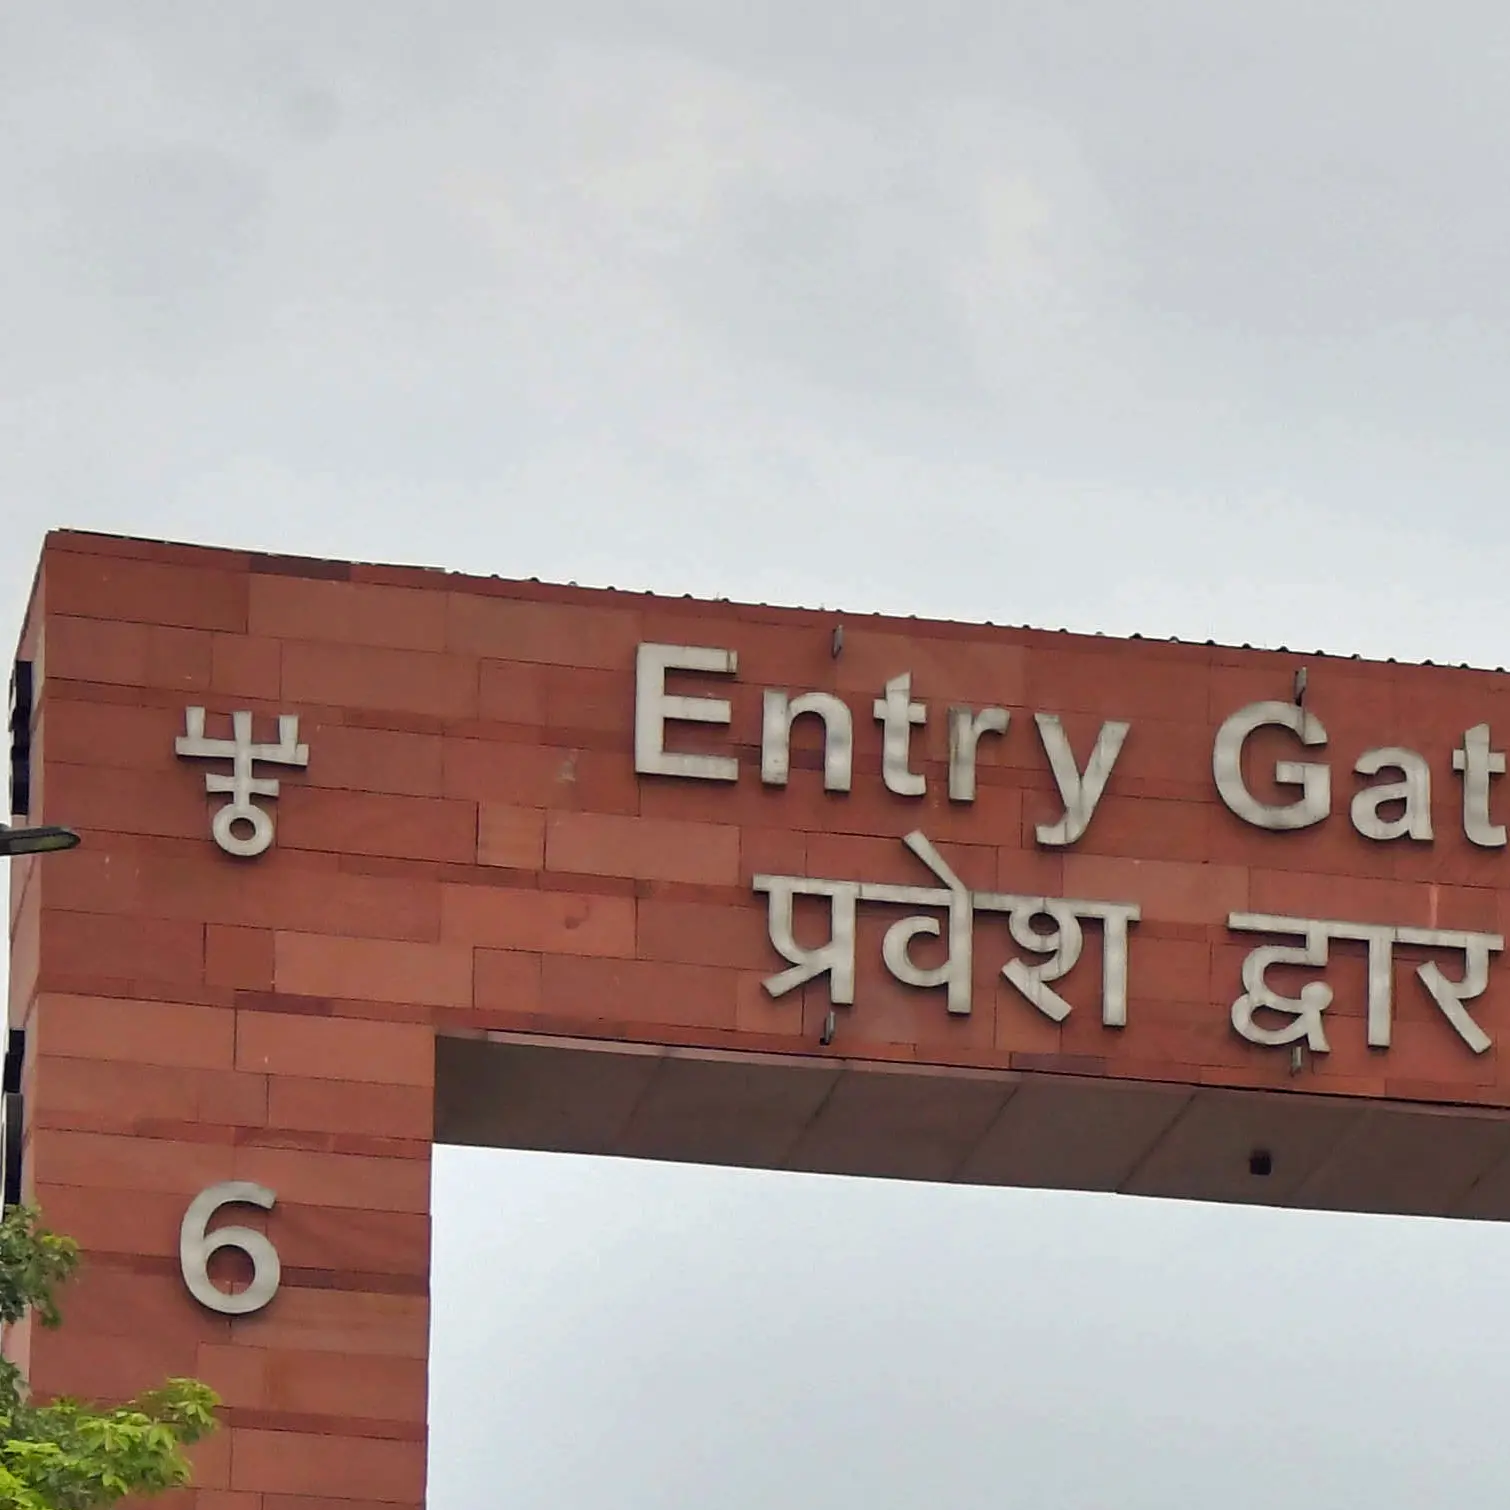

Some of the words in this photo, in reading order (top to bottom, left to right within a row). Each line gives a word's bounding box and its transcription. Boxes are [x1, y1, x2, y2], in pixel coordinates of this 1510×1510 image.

[636, 642, 1131, 848] Entry
[753, 829, 1141, 1028] प्रवेश
[1227, 910, 1505, 1056] द्वार
[179, 1180, 281, 1315] 6
